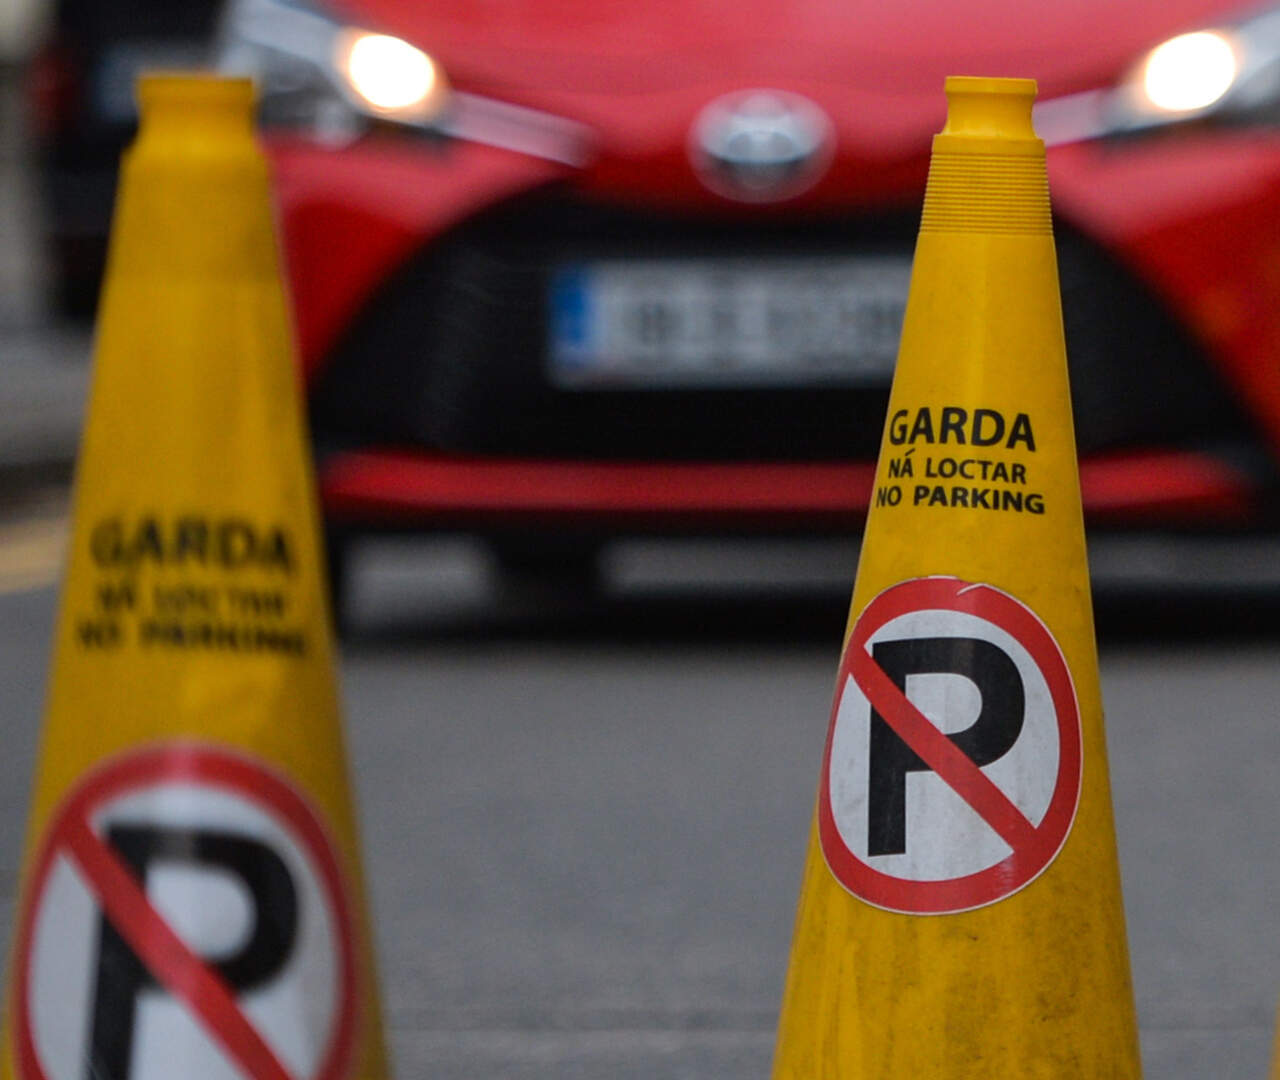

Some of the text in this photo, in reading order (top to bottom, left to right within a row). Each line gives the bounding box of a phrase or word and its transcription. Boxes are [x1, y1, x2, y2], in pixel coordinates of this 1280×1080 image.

[889, 406, 1036, 453] GARDA
[888, 448, 1027, 486] NÁ LOCTAR
[876, 484, 1046, 515] NO PARKING
[90, 514, 292, 572] GARDA
[867, 636, 1026, 857] P
